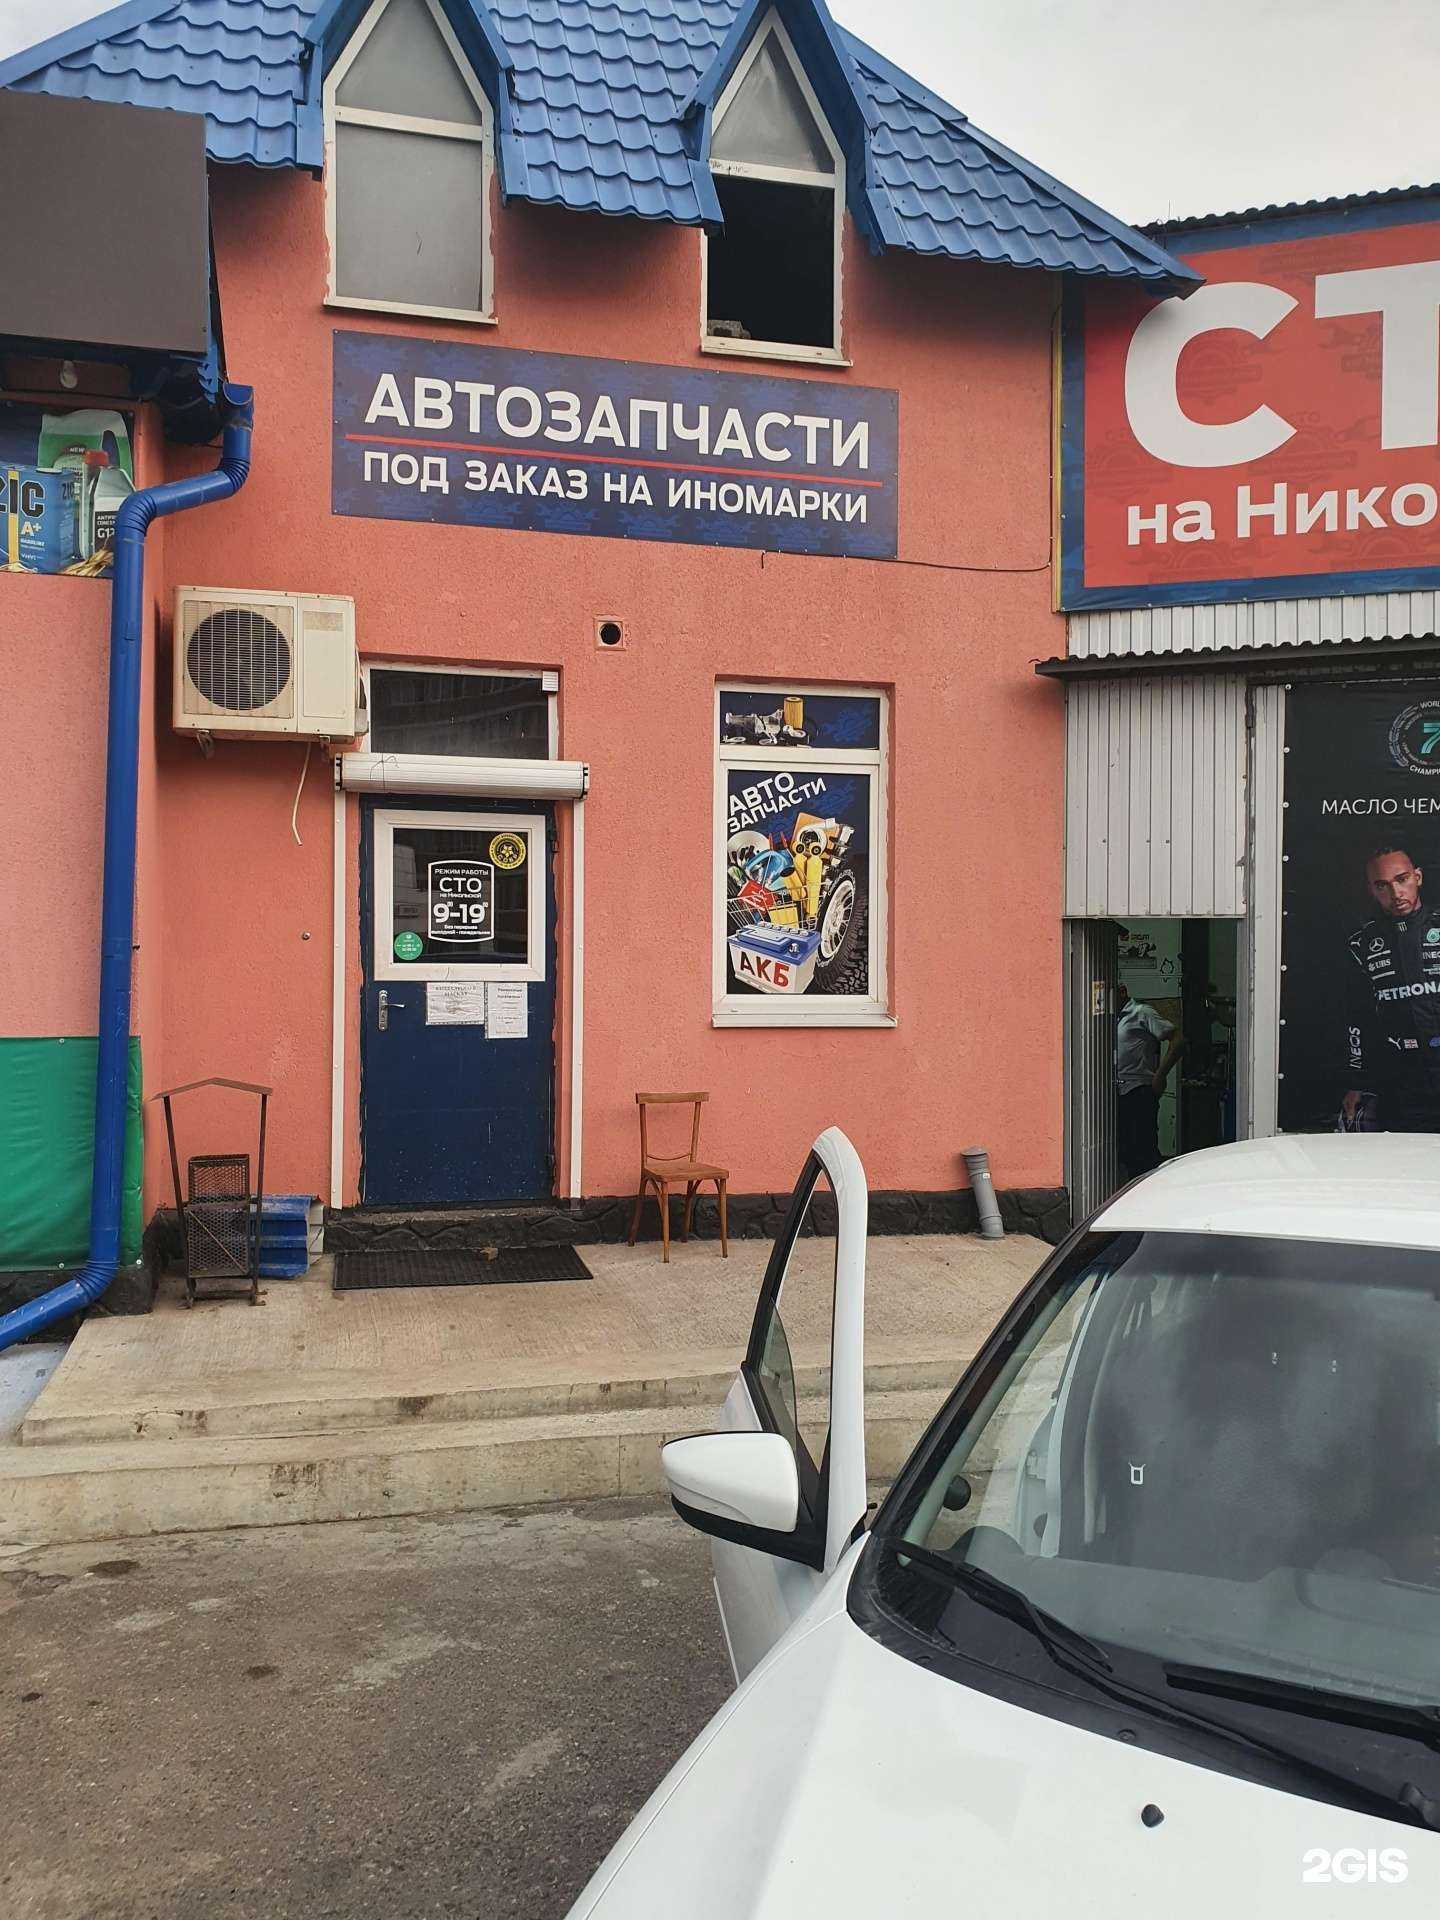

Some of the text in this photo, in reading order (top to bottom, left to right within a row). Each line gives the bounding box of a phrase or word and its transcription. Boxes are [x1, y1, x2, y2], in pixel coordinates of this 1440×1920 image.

[365, 373, 869, 469] АВТОЗАПЧАСТИ
[364, 451, 867, 523] ПОД ЗАКАЗ НА ИНОМАРКИ
[21, 521, 42, 536] A+
[1127, 483, 1438, 545] на Нико
[728, 777, 827, 833] ЗАПЧАСТИ
[729, 772, 795, 816] АВТО
[1322, 798, 1397, 815] МАСЛО
[439, 877, 482, 893] СТО
[739, 951, 790, 988] АКБ
[1348, 1026, 1362, 1069] INEOS
